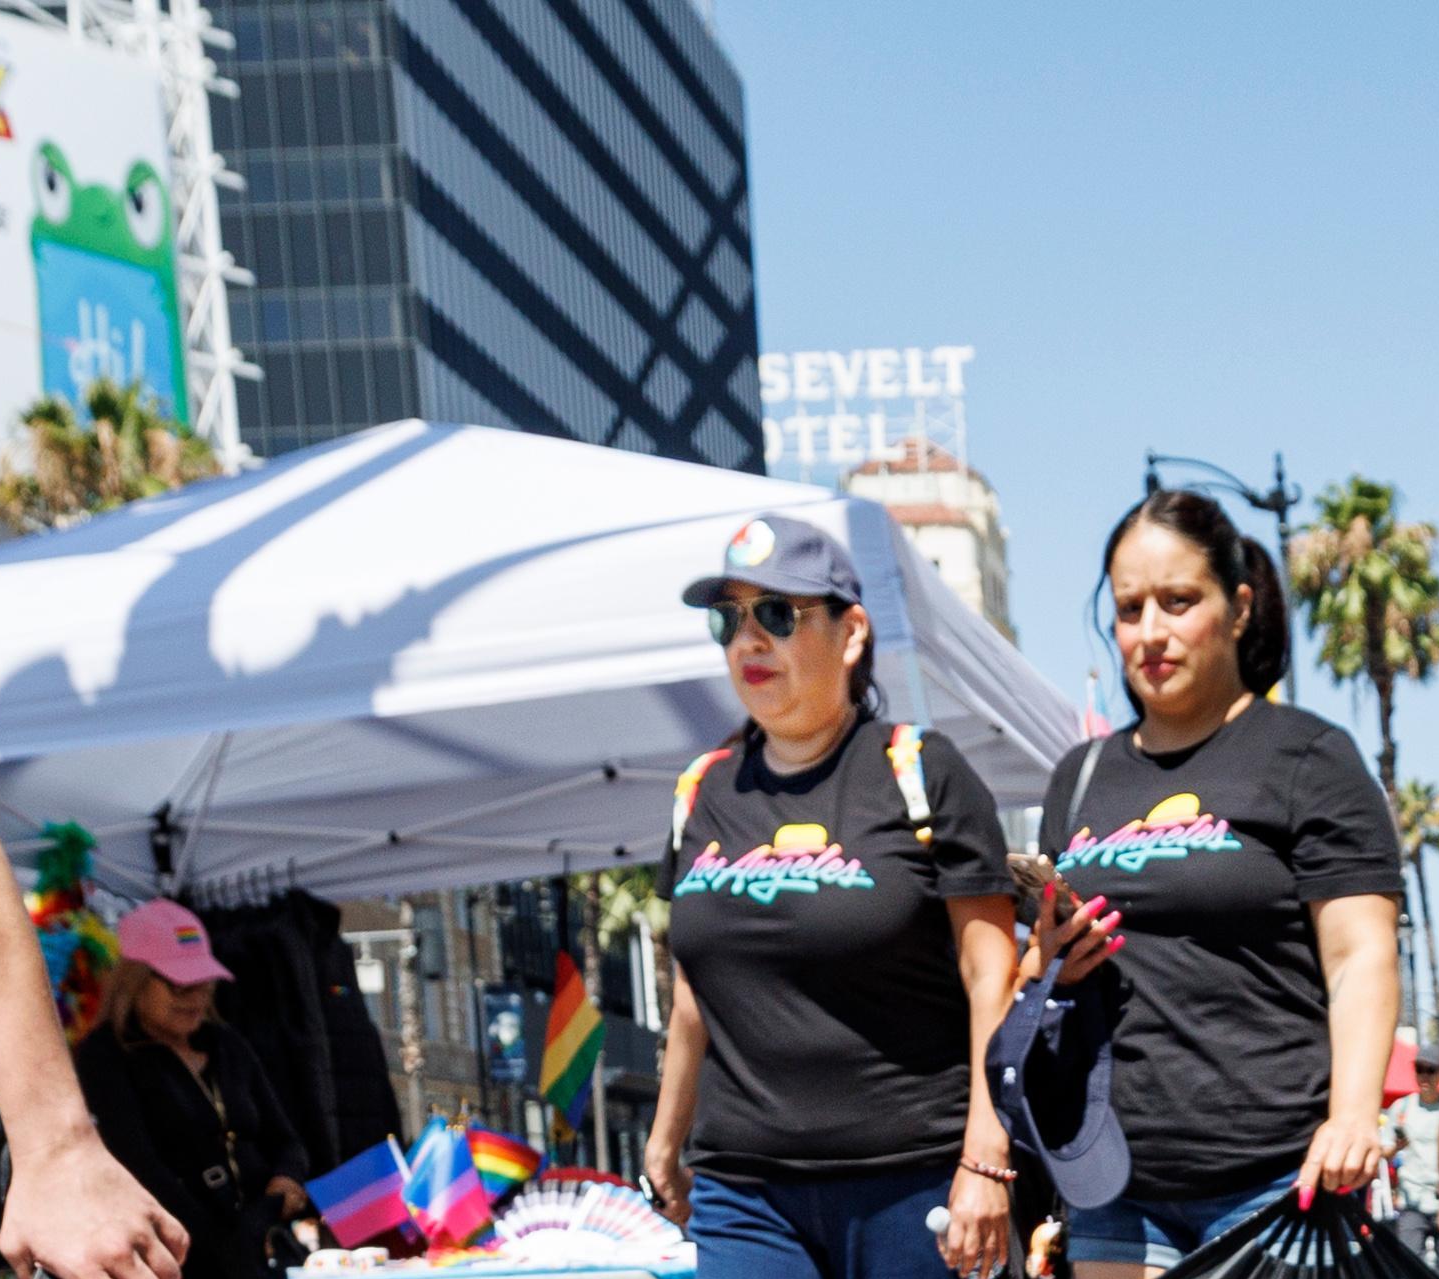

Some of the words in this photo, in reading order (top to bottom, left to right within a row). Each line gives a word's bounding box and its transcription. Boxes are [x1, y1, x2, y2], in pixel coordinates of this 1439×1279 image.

[758, 345, 975, 404] SEVELT
[674, 841, 729, 896] Los
[711, 842, 875, 905] Angeles
[1080, 813, 1243, 873] Angeles
